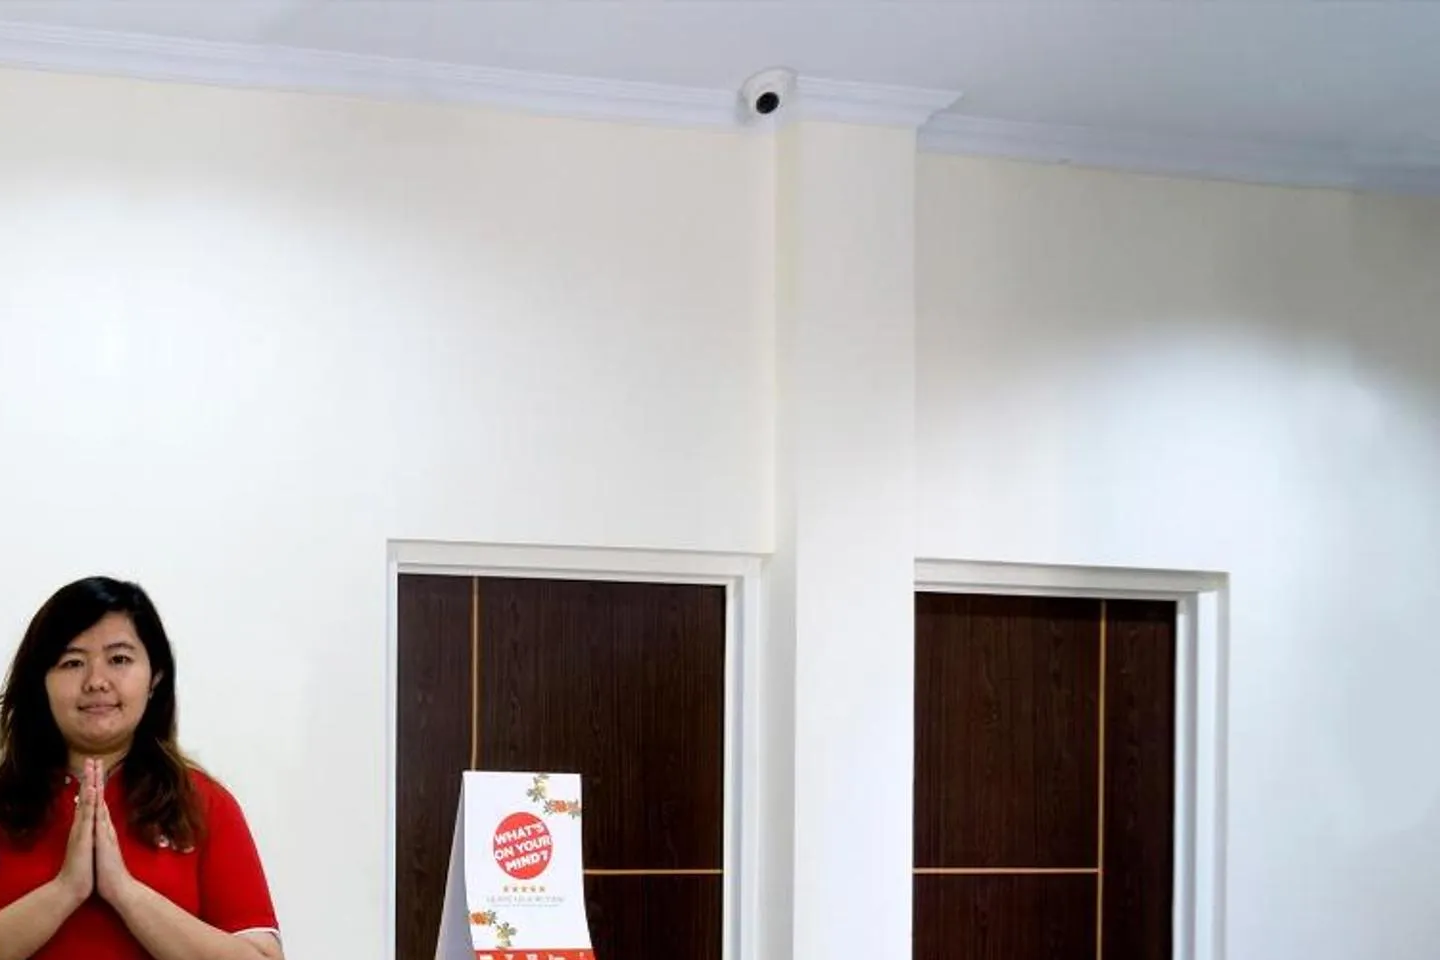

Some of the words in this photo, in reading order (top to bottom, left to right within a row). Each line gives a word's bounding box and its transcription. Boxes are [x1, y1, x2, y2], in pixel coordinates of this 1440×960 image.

[495, 823, 545, 844] WHAT'S
[494, 846, 515, 859] ON
[516, 835, 552, 853] YOUR
[505, 850, 548, 871] MIND?
